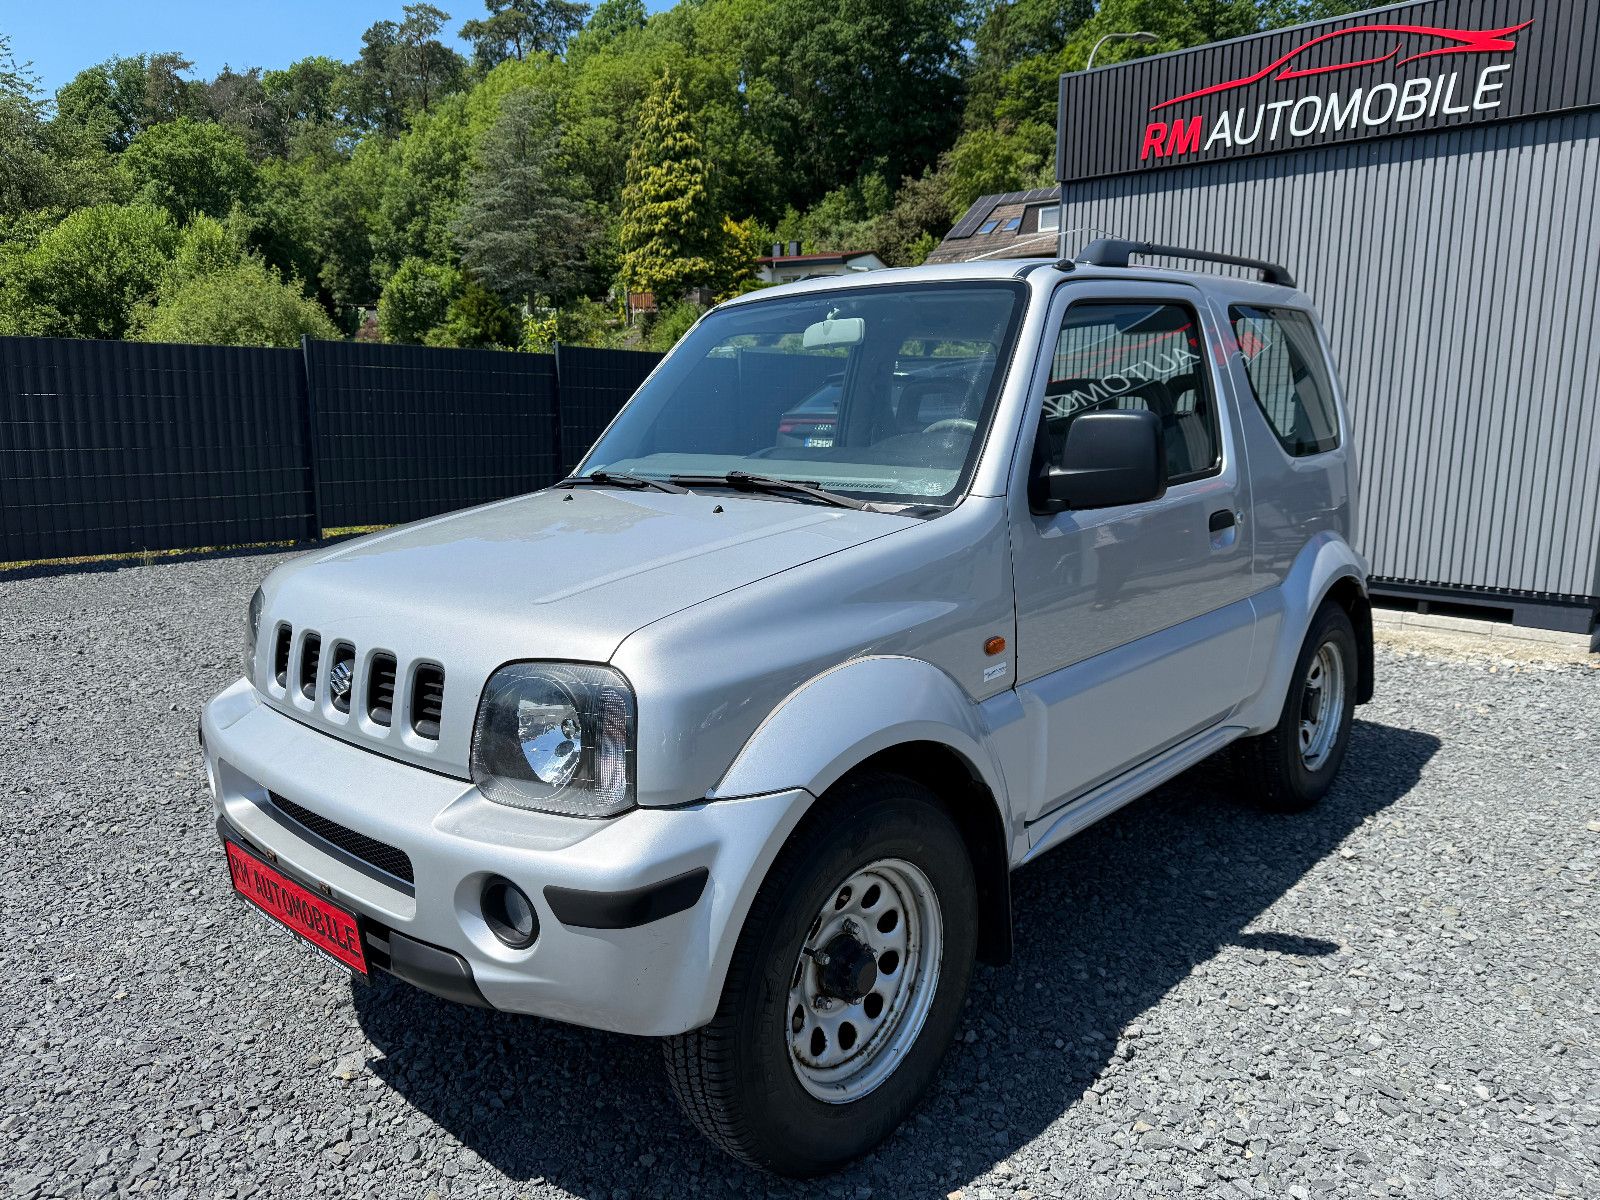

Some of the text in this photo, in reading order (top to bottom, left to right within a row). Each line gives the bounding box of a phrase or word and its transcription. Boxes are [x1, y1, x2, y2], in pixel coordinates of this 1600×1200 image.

[1141, 64, 1510, 160] RM AUTOMOBILE
[231, 853, 252, 889] RM
[254, 868, 360, 958] AUTOMOBILE
